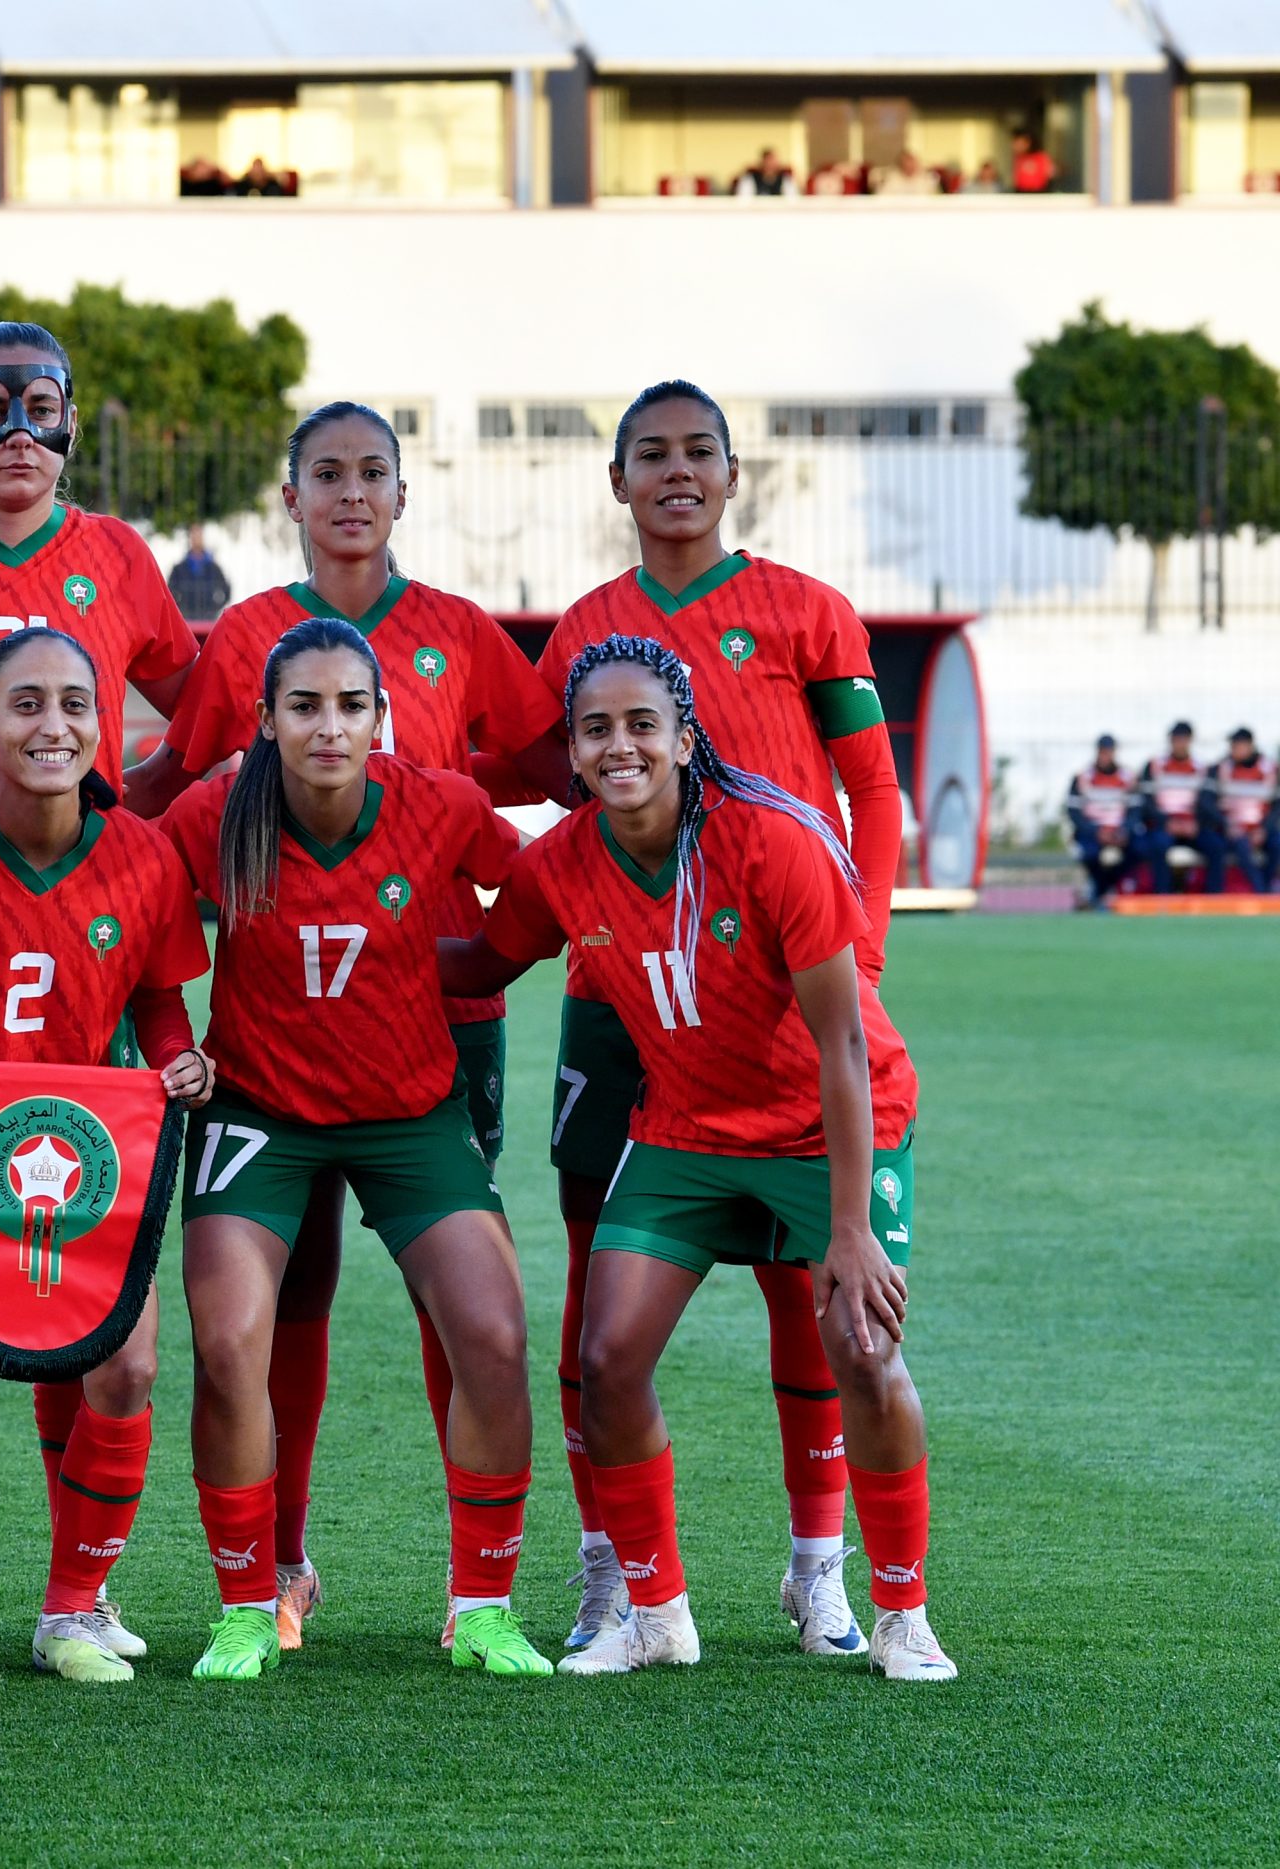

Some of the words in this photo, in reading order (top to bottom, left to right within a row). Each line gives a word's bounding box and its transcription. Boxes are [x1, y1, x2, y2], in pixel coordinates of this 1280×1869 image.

[581, 935, 611, 947] PUMA
[298, 924, 368, 998] 17
[3, 951, 56, 1034] 2
[641, 950, 702, 1030] 11
[551, 1064, 589, 1147] 7
[1, 1126, 32, 1154] ROYALE
[36, 1123, 87, 1152] MAROCAINE
[82, 1154, 93, 1167] DE
[194, 1122, 270, 1196] 17
[67, 1169, 94, 1211] FOOTBALL
[809, 1445, 846, 1460] PUM
[874, 1567, 912, 1583] PUMA
